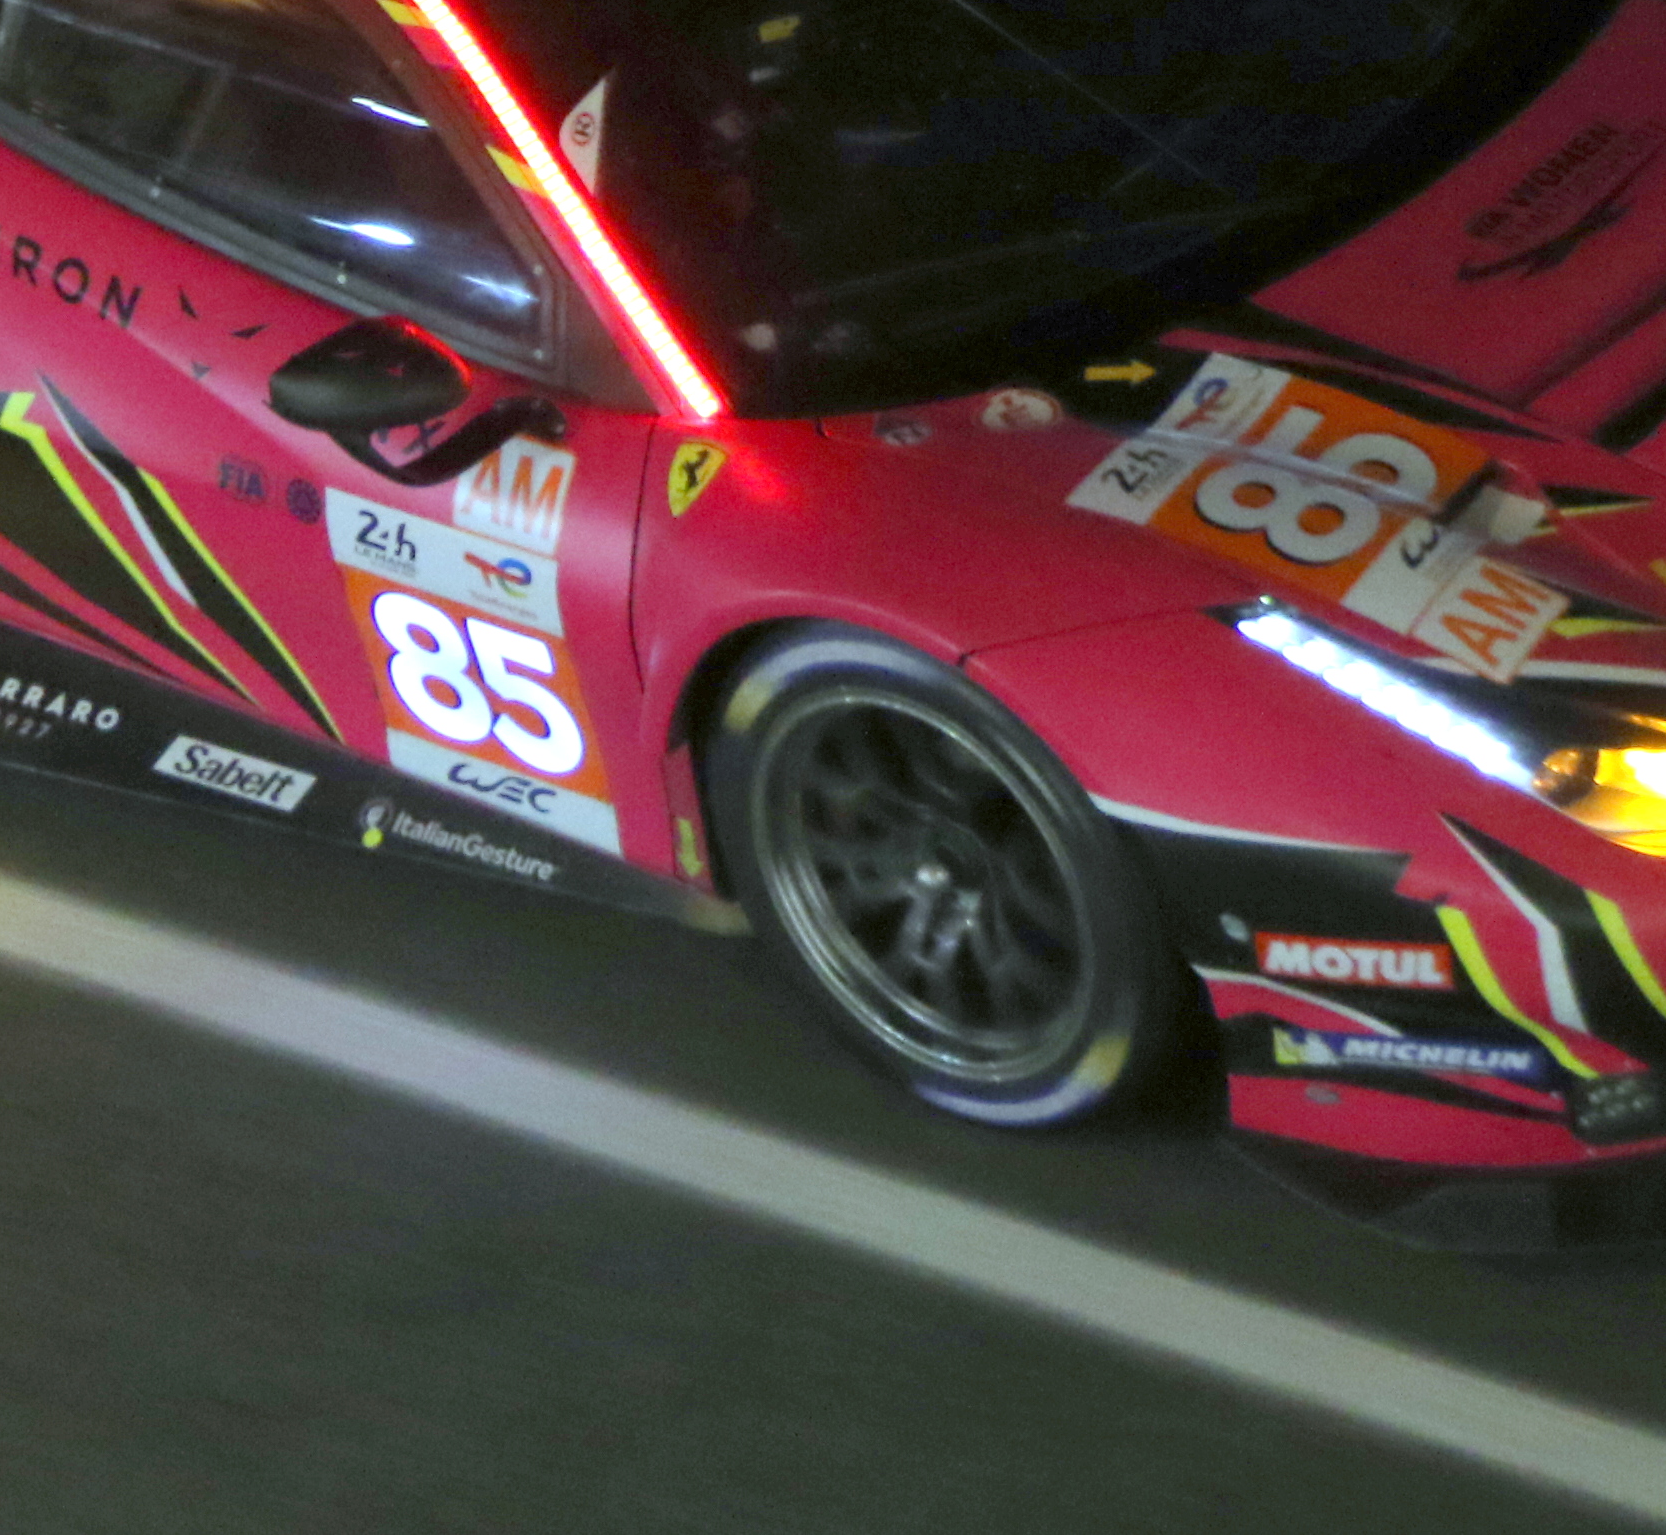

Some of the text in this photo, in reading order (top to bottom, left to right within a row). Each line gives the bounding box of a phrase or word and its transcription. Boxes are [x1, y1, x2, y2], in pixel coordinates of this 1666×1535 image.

[220, 459, 266, 500] FIA
[461, 454, 568, 539] AM
[1194, 404, 1439, 566] 85
[1438, 564, 1552, 667] AM
[370, 590, 586, 775] 85
[173, 743, 297, 804] Sabelt
[392, 810, 557, 881] ItalianGesture
[1264, 941, 1445, 985] MOTUL
[1341, 1036, 1532, 1070] MICHELIN
